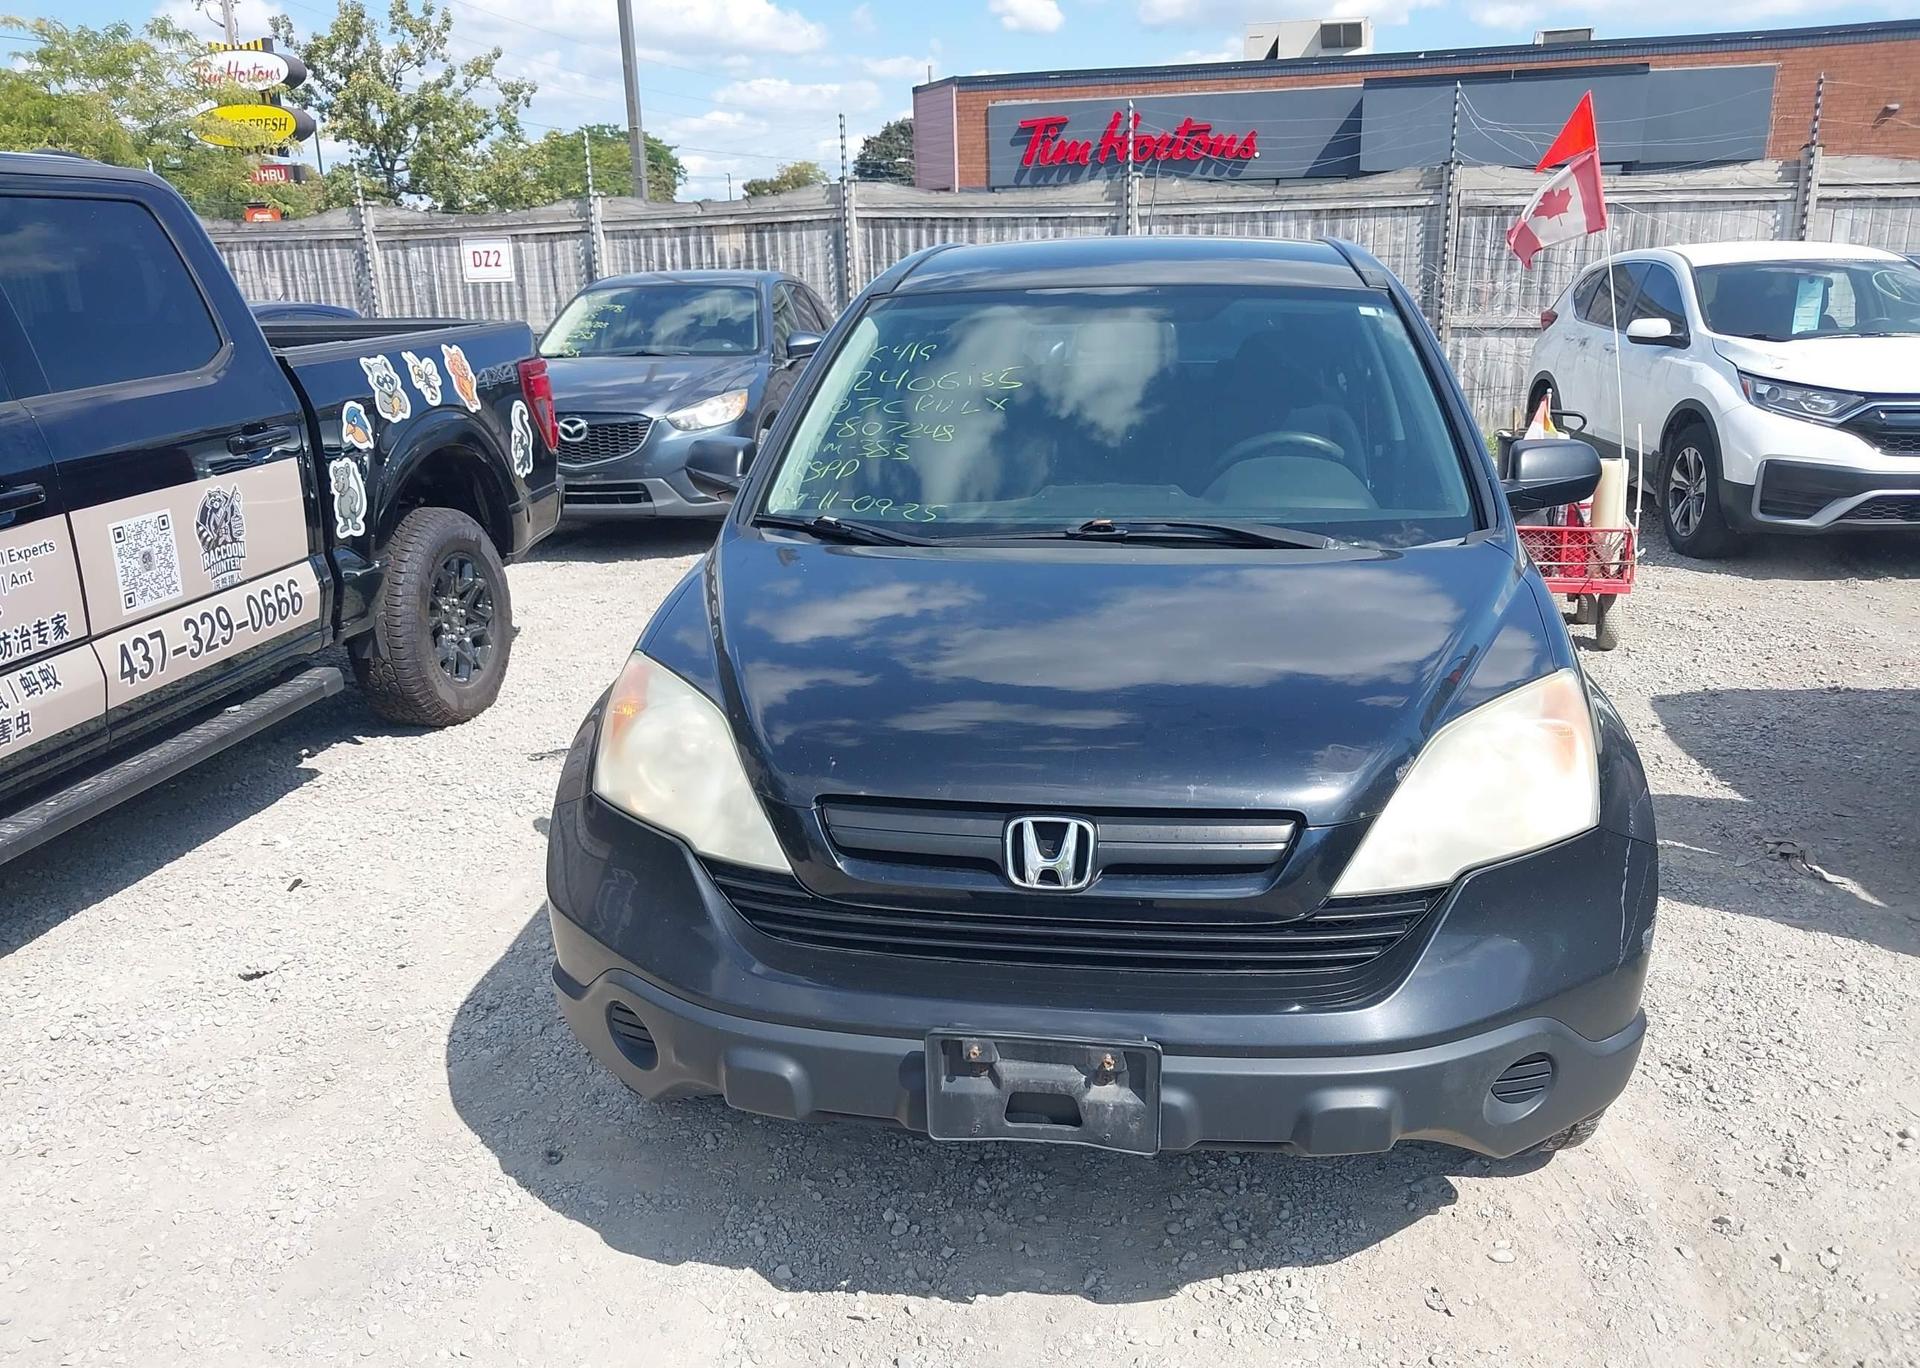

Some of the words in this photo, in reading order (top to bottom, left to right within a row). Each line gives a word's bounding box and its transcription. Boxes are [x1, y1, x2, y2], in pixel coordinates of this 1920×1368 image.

[226, 60, 281, 83] Hortons
[1018, 115, 1092, 167] Tim
[1098, 110, 1258, 163] Hortons
[472, 249, 503, 268] DZ2
[7, 541, 56, 563] Experts
[202, 541, 245, 571] RACCOON
[10, 570, 34, 588] Ant
[210, 557, 241, 579] HUNTER
[0, 613, 70, 661] 防治专家
[118, 578, 304, 687] 437-329-0666
[19, 663, 62, 698] 蚂蚁
